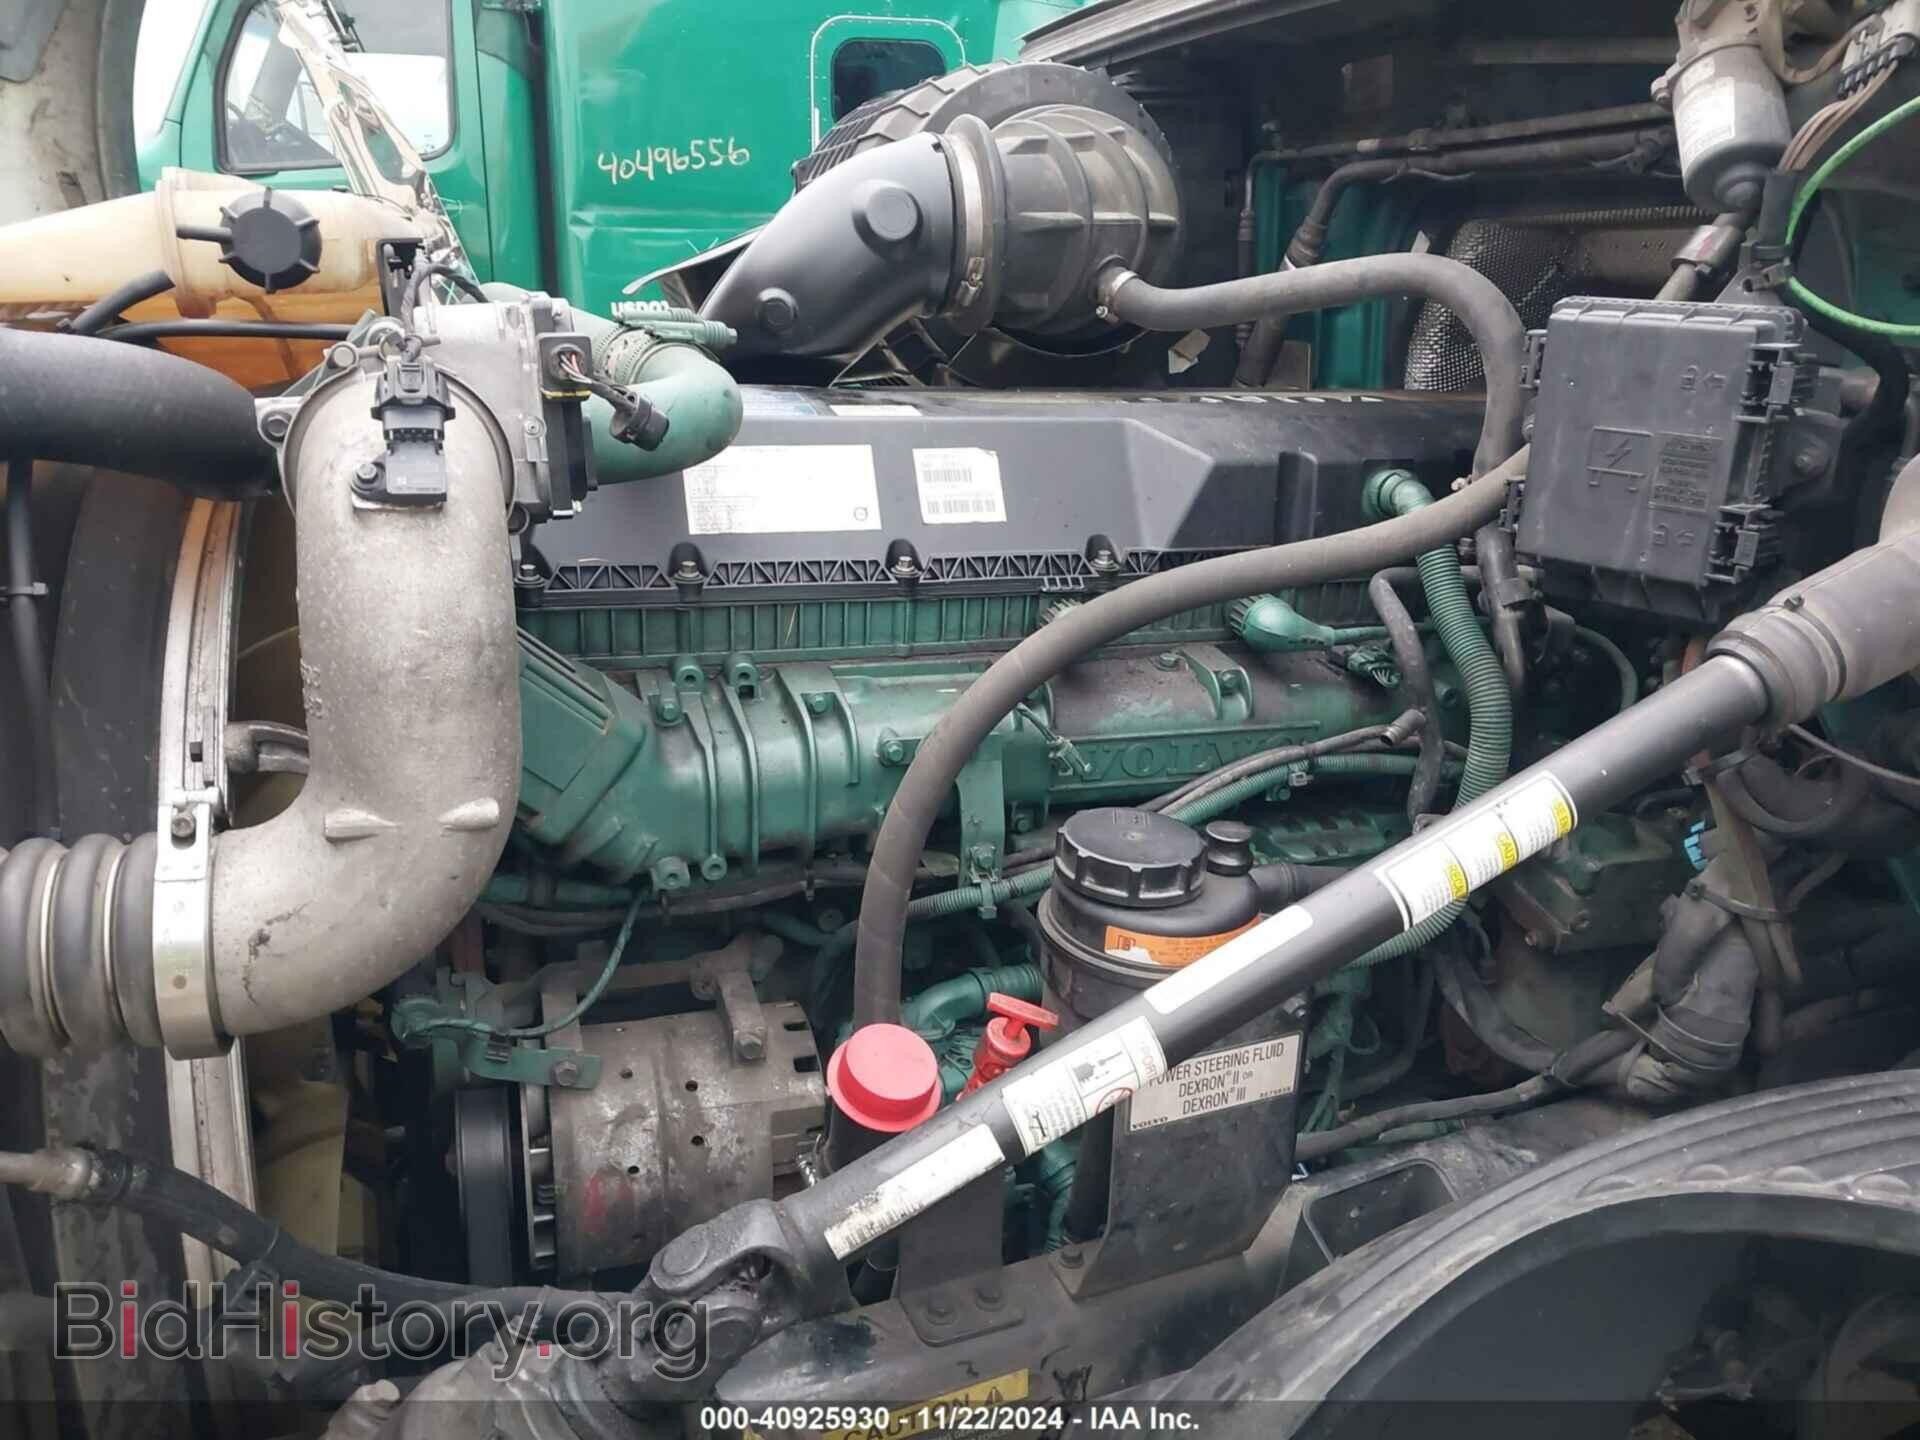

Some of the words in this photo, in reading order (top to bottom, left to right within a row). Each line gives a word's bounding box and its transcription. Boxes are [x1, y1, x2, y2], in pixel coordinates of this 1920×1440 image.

[598, 137, 750, 185] 40496556
[1194, 1049, 1250, 1077] STEERING
[1252, 1041, 1285, 1064] FLUID
